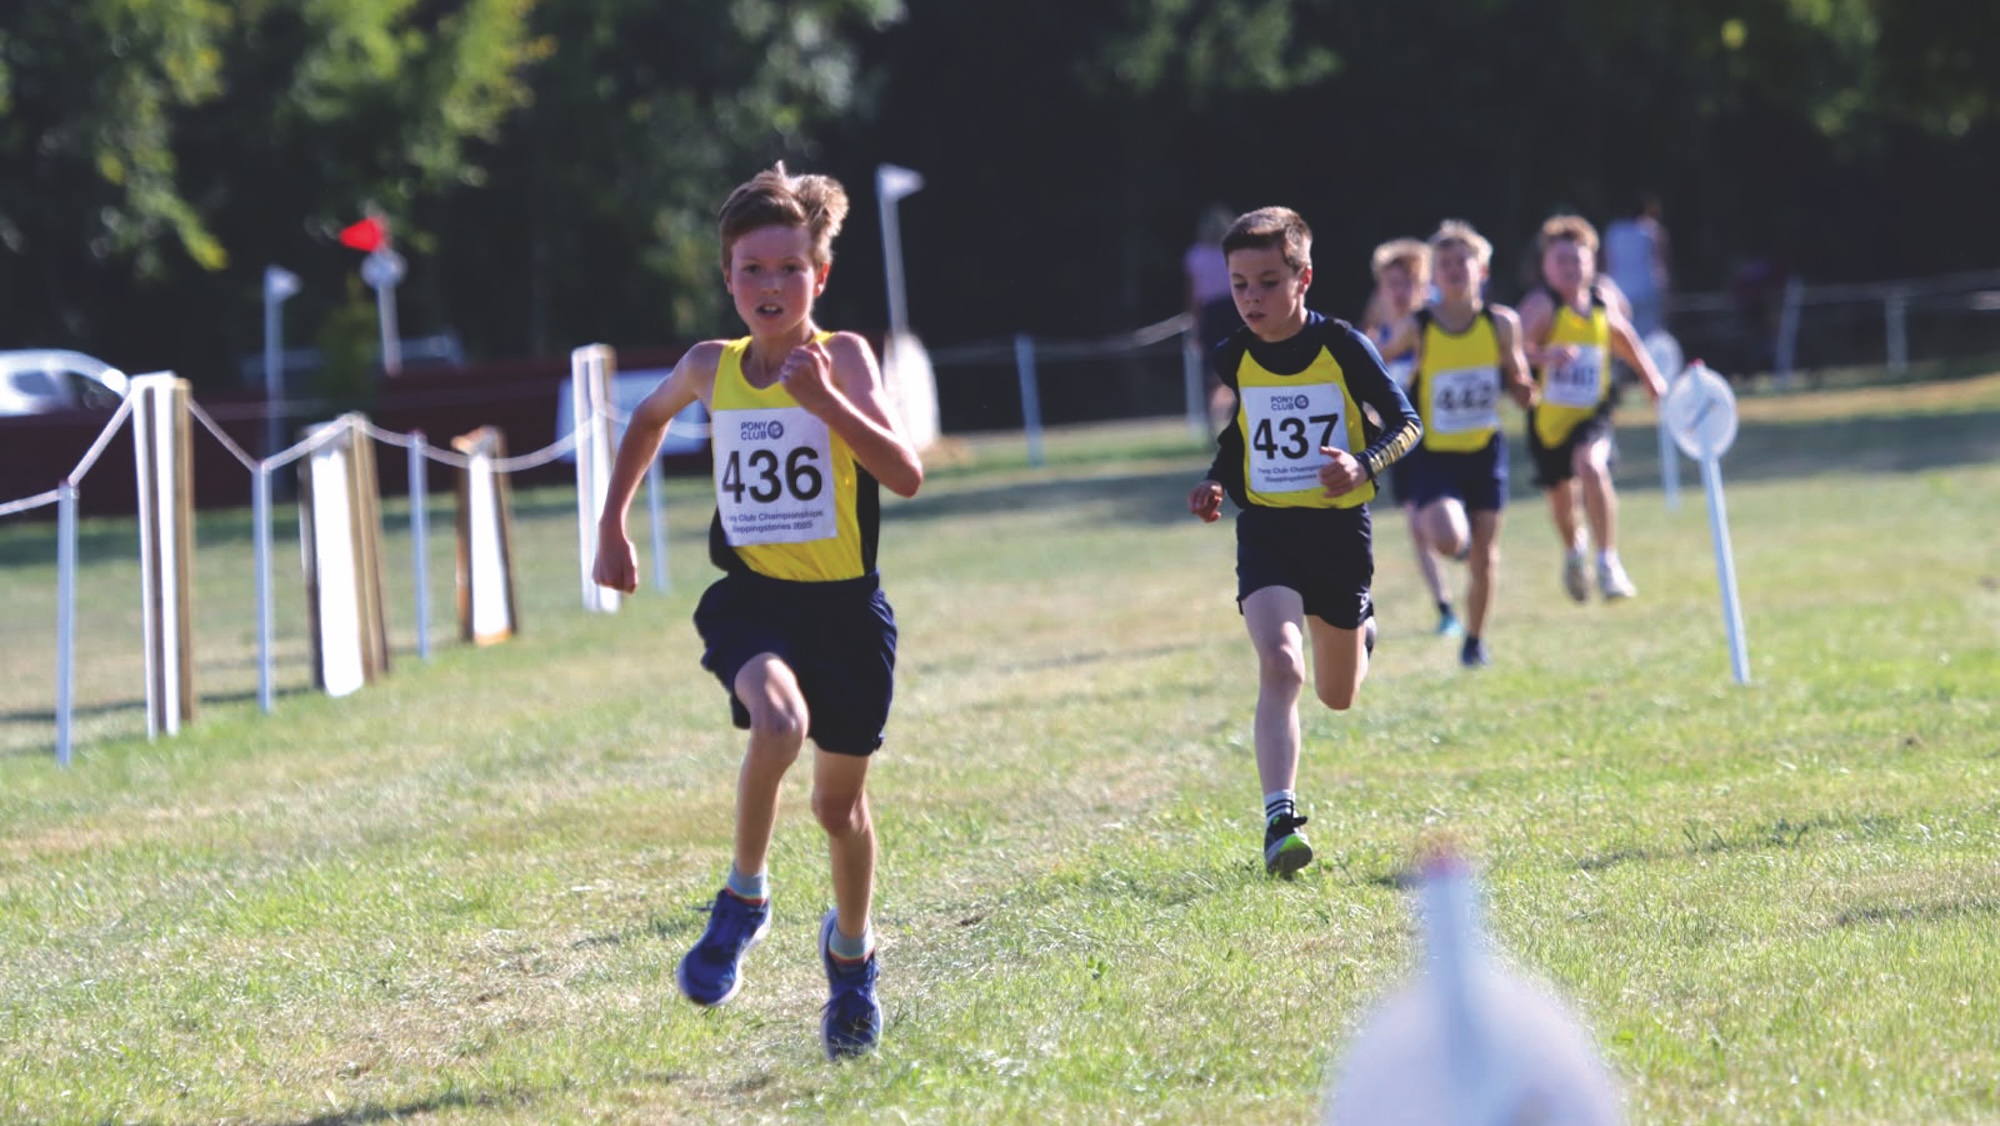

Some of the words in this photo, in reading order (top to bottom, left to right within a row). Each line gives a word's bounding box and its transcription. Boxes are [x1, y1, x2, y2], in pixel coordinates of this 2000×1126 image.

[1270, 395, 1294, 404] PONY
[1271, 402, 1295, 411] CLUB
[740, 421, 767, 431] PONY
[741, 431, 767, 440] CLUB
[1253, 413, 1339, 460] 437
[722, 446, 822, 504] 436
[738, 513, 757, 522] Club
[758, 509, 824, 521] Championships
